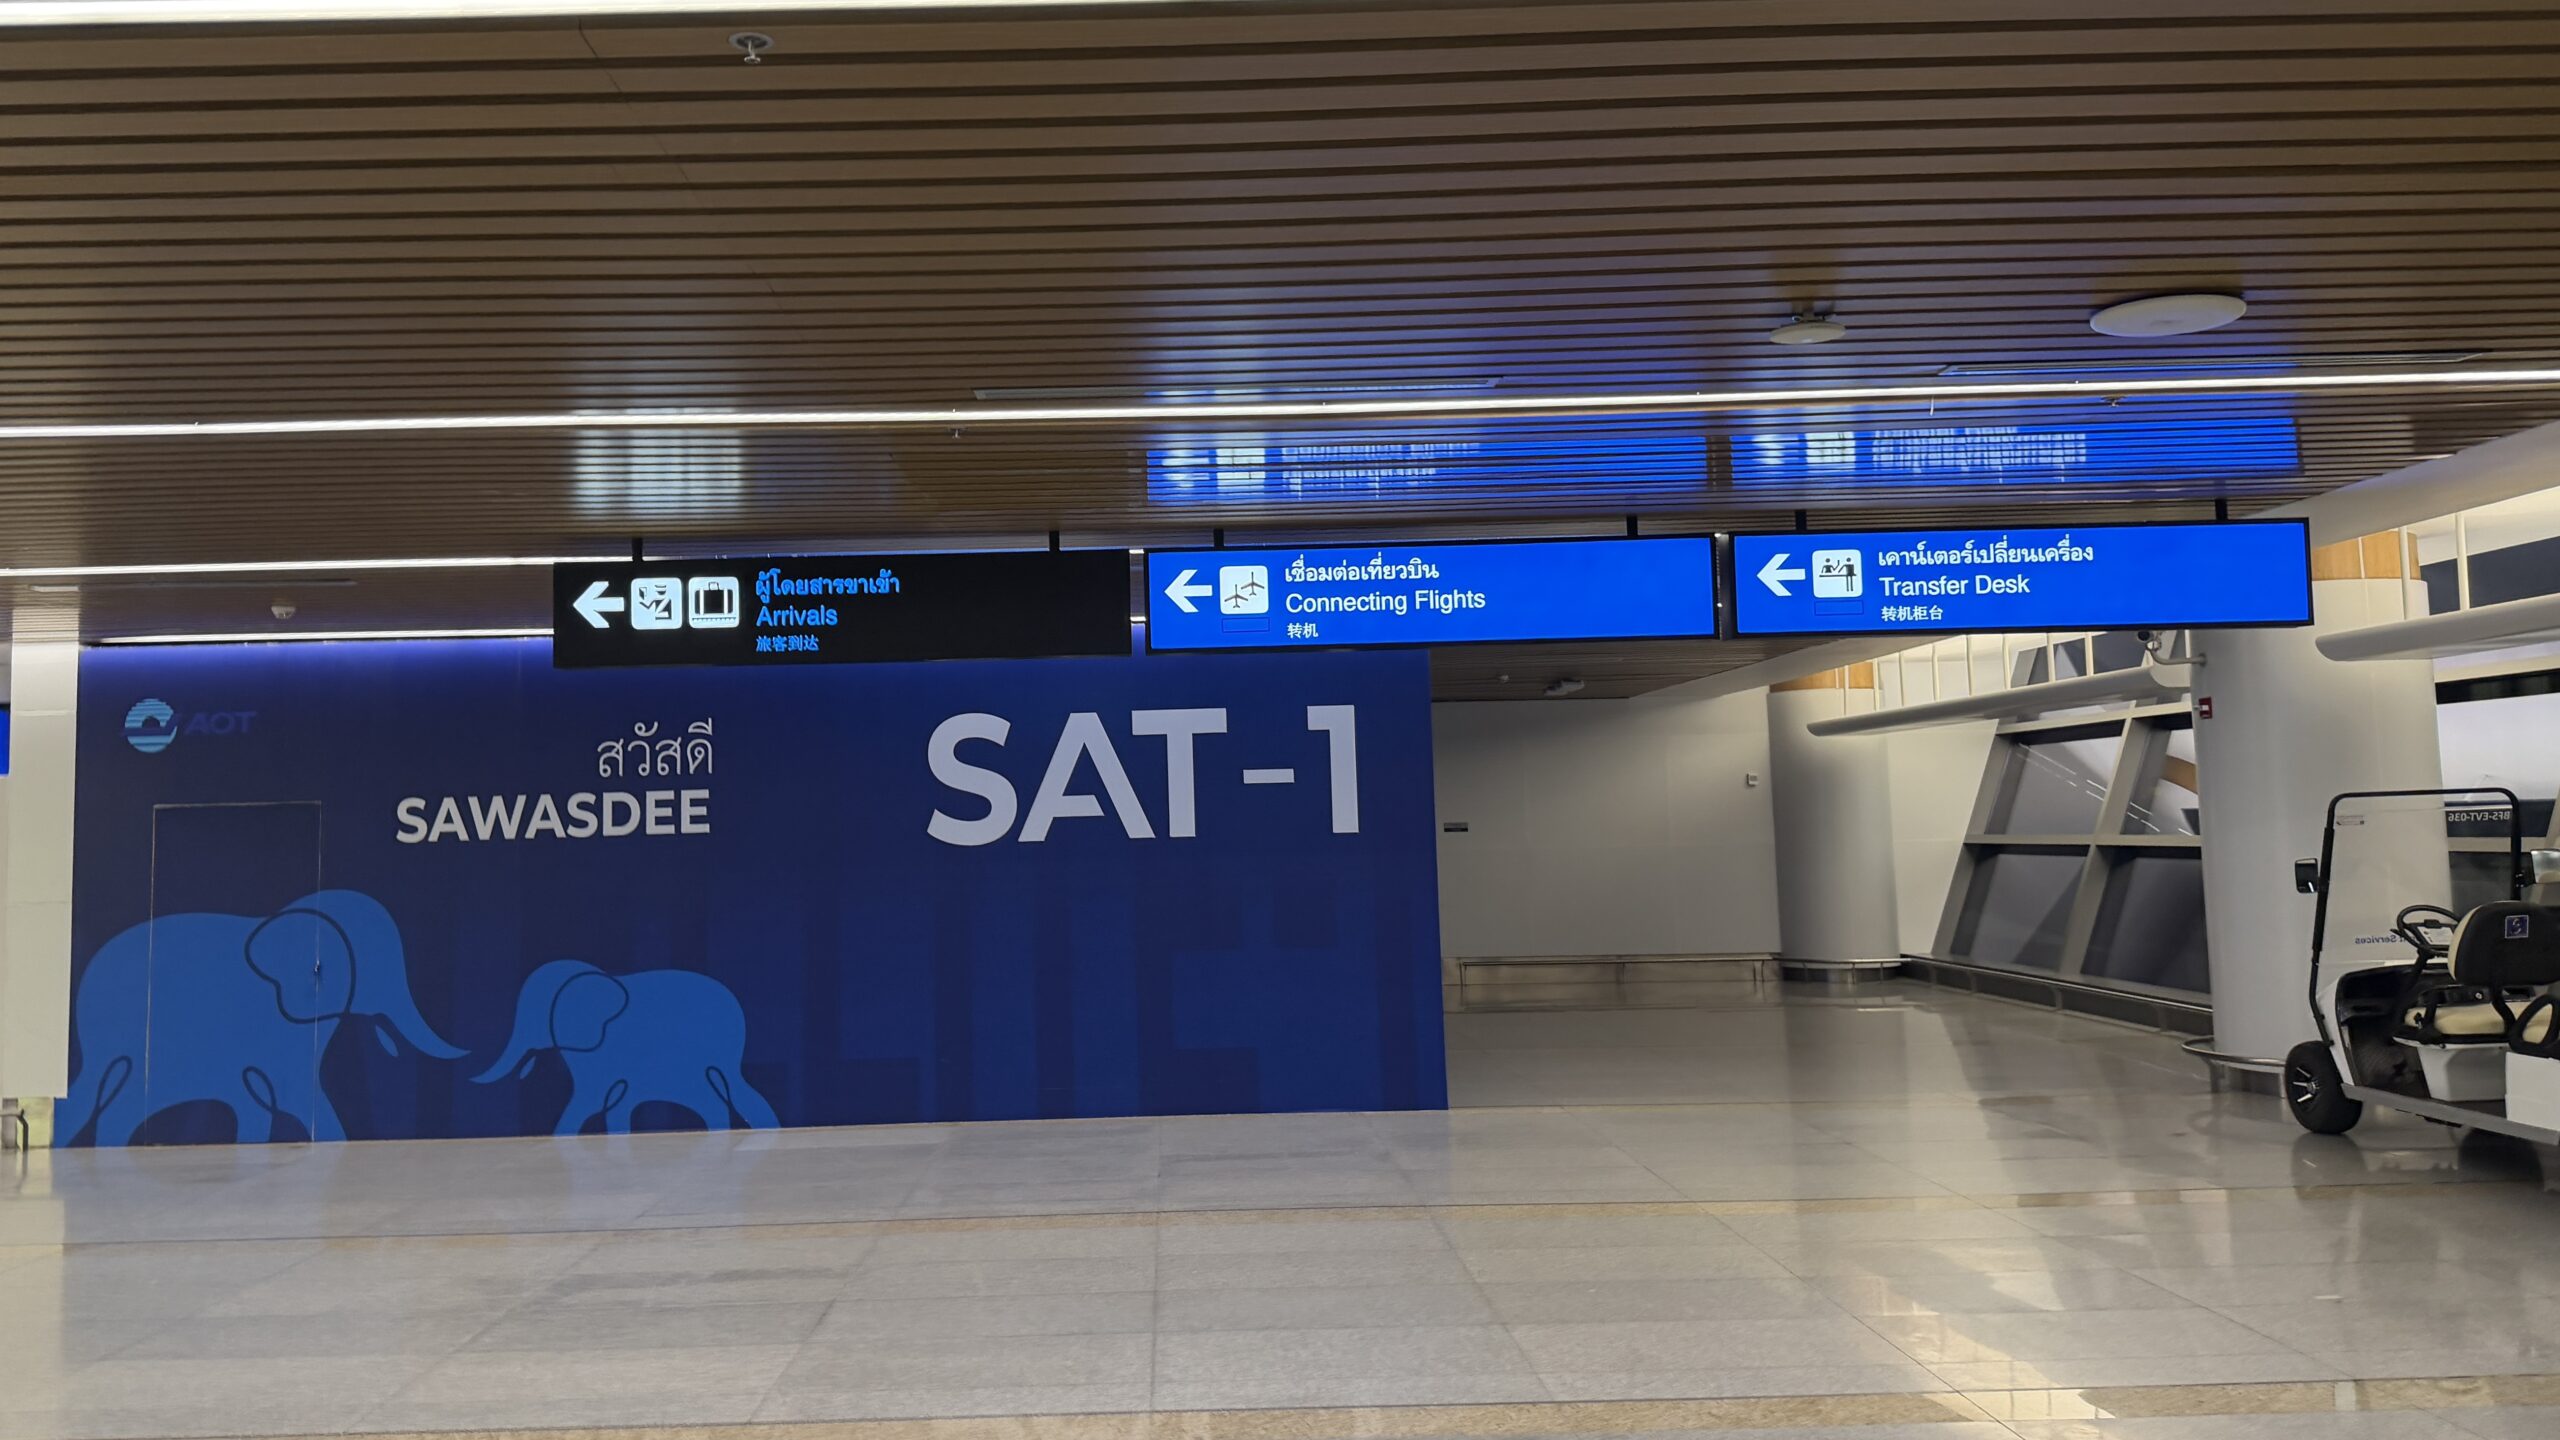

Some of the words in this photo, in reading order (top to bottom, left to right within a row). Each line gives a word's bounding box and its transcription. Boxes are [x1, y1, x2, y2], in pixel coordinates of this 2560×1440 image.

[1878, 534, 2094, 565] เคาน์เตอร์เปลี่ยนเครื่อง
[1285, 552, 1439, 582] เชื่อมต่อเที่ยวบิน
[755, 568, 900, 603] ผู้โดยสารขาเข้า
[1879, 576, 1968, 597] Transfer
[1975, 574, 2030, 595] Desk
[1286, 591, 1407, 615] Connecting
[1415, 589, 1486, 614] Flights
[1881, 605, 1943, 621] 转机柜台
[756, 604, 838, 627] Arrivals
[1287, 622, 1319, 638] 转机
[756, 634, 819, 652] 旅客到达
[184, 710, 257, 735] AOT
[597, 718, 713, 777] สวัสดี
[396, 789, 710, 843] SAWASDEE
